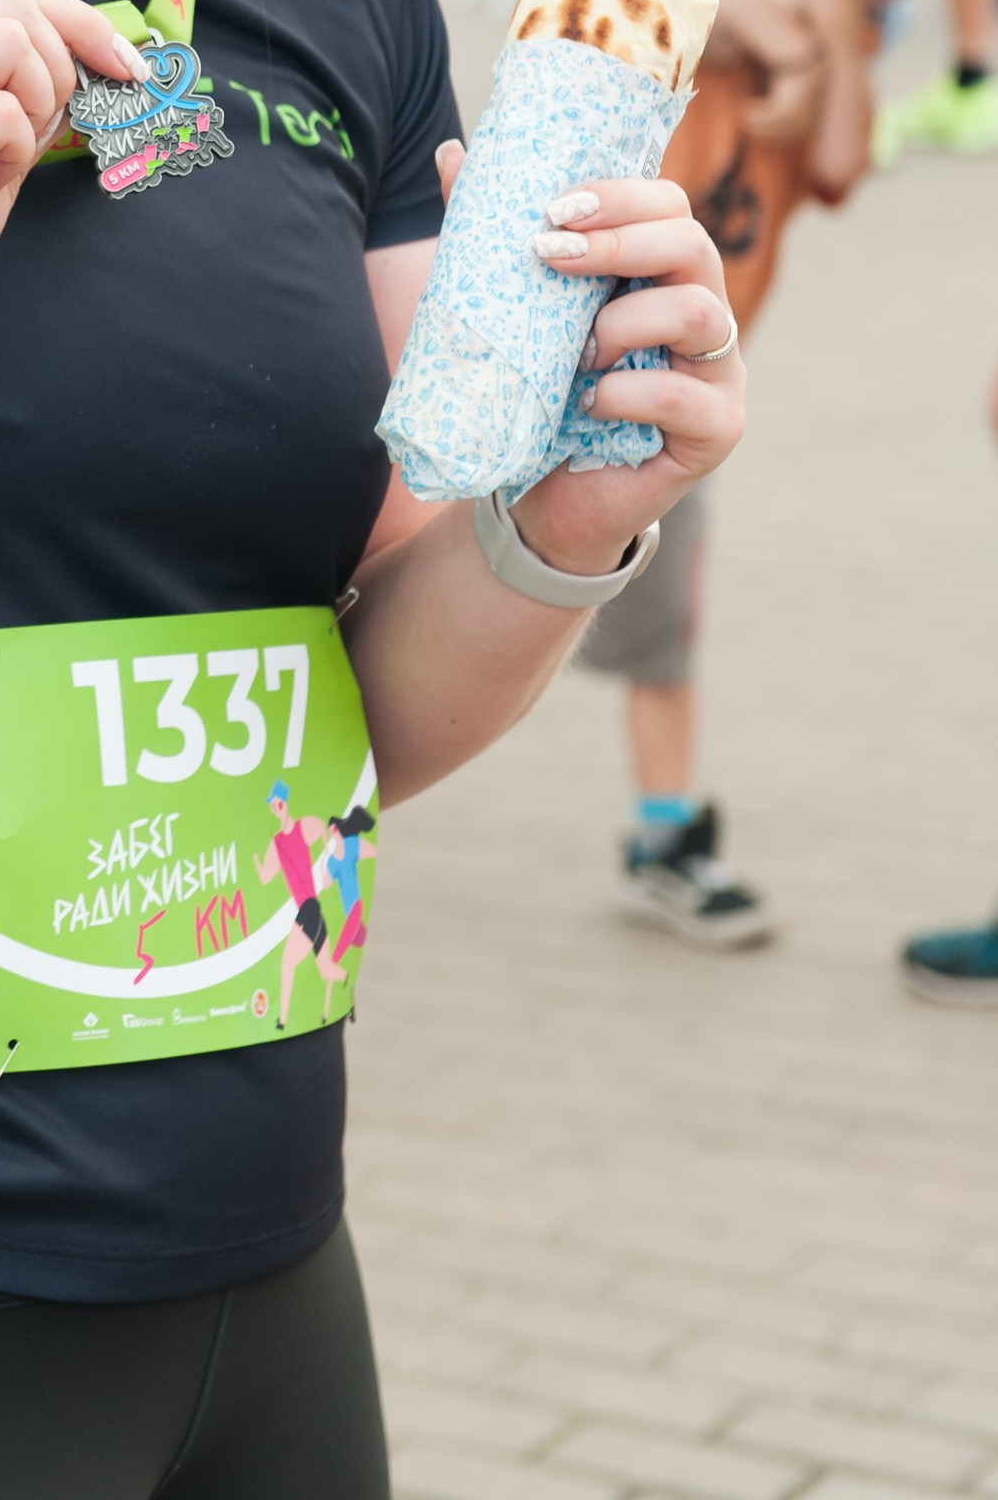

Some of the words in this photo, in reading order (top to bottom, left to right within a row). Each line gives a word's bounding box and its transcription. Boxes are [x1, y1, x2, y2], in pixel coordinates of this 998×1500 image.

[108, 173, 119, 186] 5
[71, 643, 310, 787] 1337
[87, 812, 180, 880] ЗАБЕГ
[53, 878, 131, 935] РАДИ
[136, 841, 238, 914] ЖИЗНИ
[133, 909, 166, 986] 5
